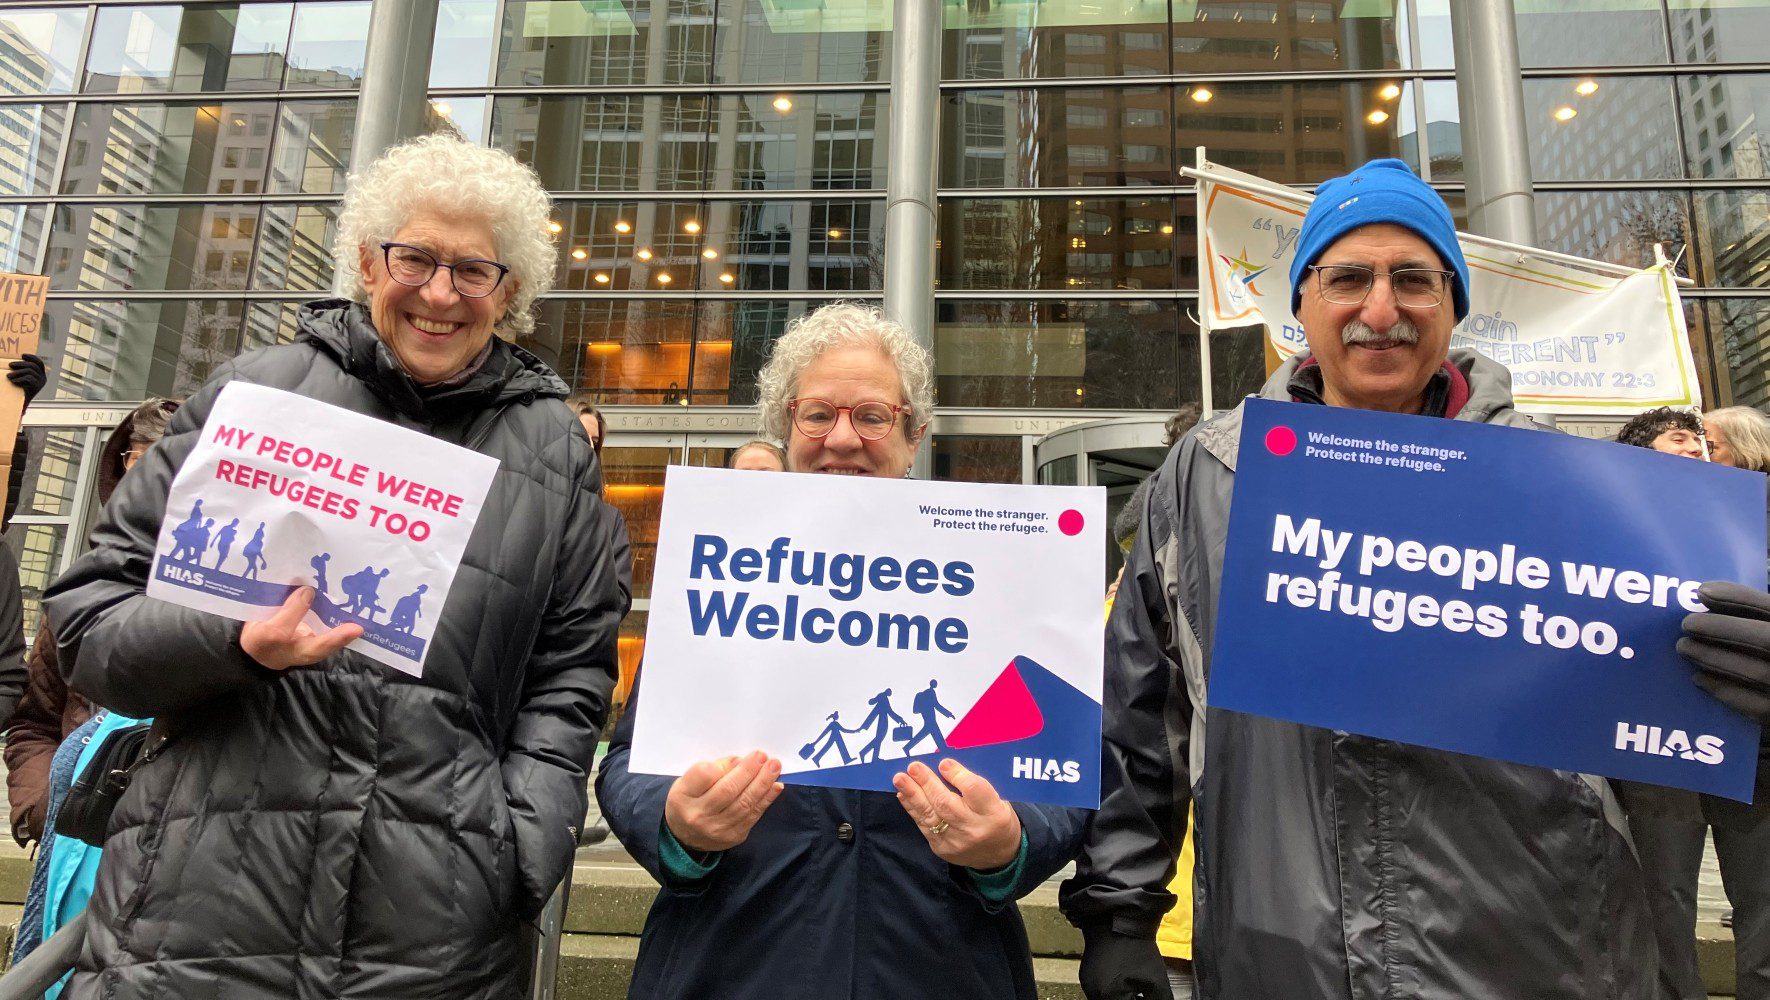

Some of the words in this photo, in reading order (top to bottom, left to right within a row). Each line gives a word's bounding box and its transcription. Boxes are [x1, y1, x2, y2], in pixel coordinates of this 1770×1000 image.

[1512, 370, 1605, 388] RONOMY
[1612, 371, 1657, 389] 22:3
[621, 416, 693, 427] STATES
[1013, 420, 1081, 431] UNIT
[1305, 445, 1357, 463] Protect
[1358, 452, 1384, 465] the
[1384, 456, 1447, 473] refugee.
[1307, 431, 1373, 450] Welcome
[1374, 439, 1400, 453] the
[1400, 443, 1468, 461] stranger.
[213, 424, 254, 451] MY
[256, 436, 370, 487] PEOPLE
[376, 471, 465, 518] WERE
[215, 459, 361, 521] REFUGEES
[369, 505, 431, 542] TOO
[918, 504, 973, 518] Welcome
[974, 508, 995, 518] the
[995, 509, 1050, 522] stranger.
[933, 518, 976, 530] Protect
[977, 520, 998, 531] the
[999, 521, 1050, 535] refugee.
[163, 564, 205, 586] HIAS
[689, 534, 976, 602] Refugees
[1271, 514, 1354, 571] My
[1359, 532, 1551, 591] people
[1561, 561, 1710, 614] were
[686, 589, 970, 654] Welcome
[1265, 571, 1509, 638] refugees
[1519, 603, 1636, 660] too.
[1615, 721, 1726, 765] HIAS
[1012, 756, 1082, 784] HIAS
